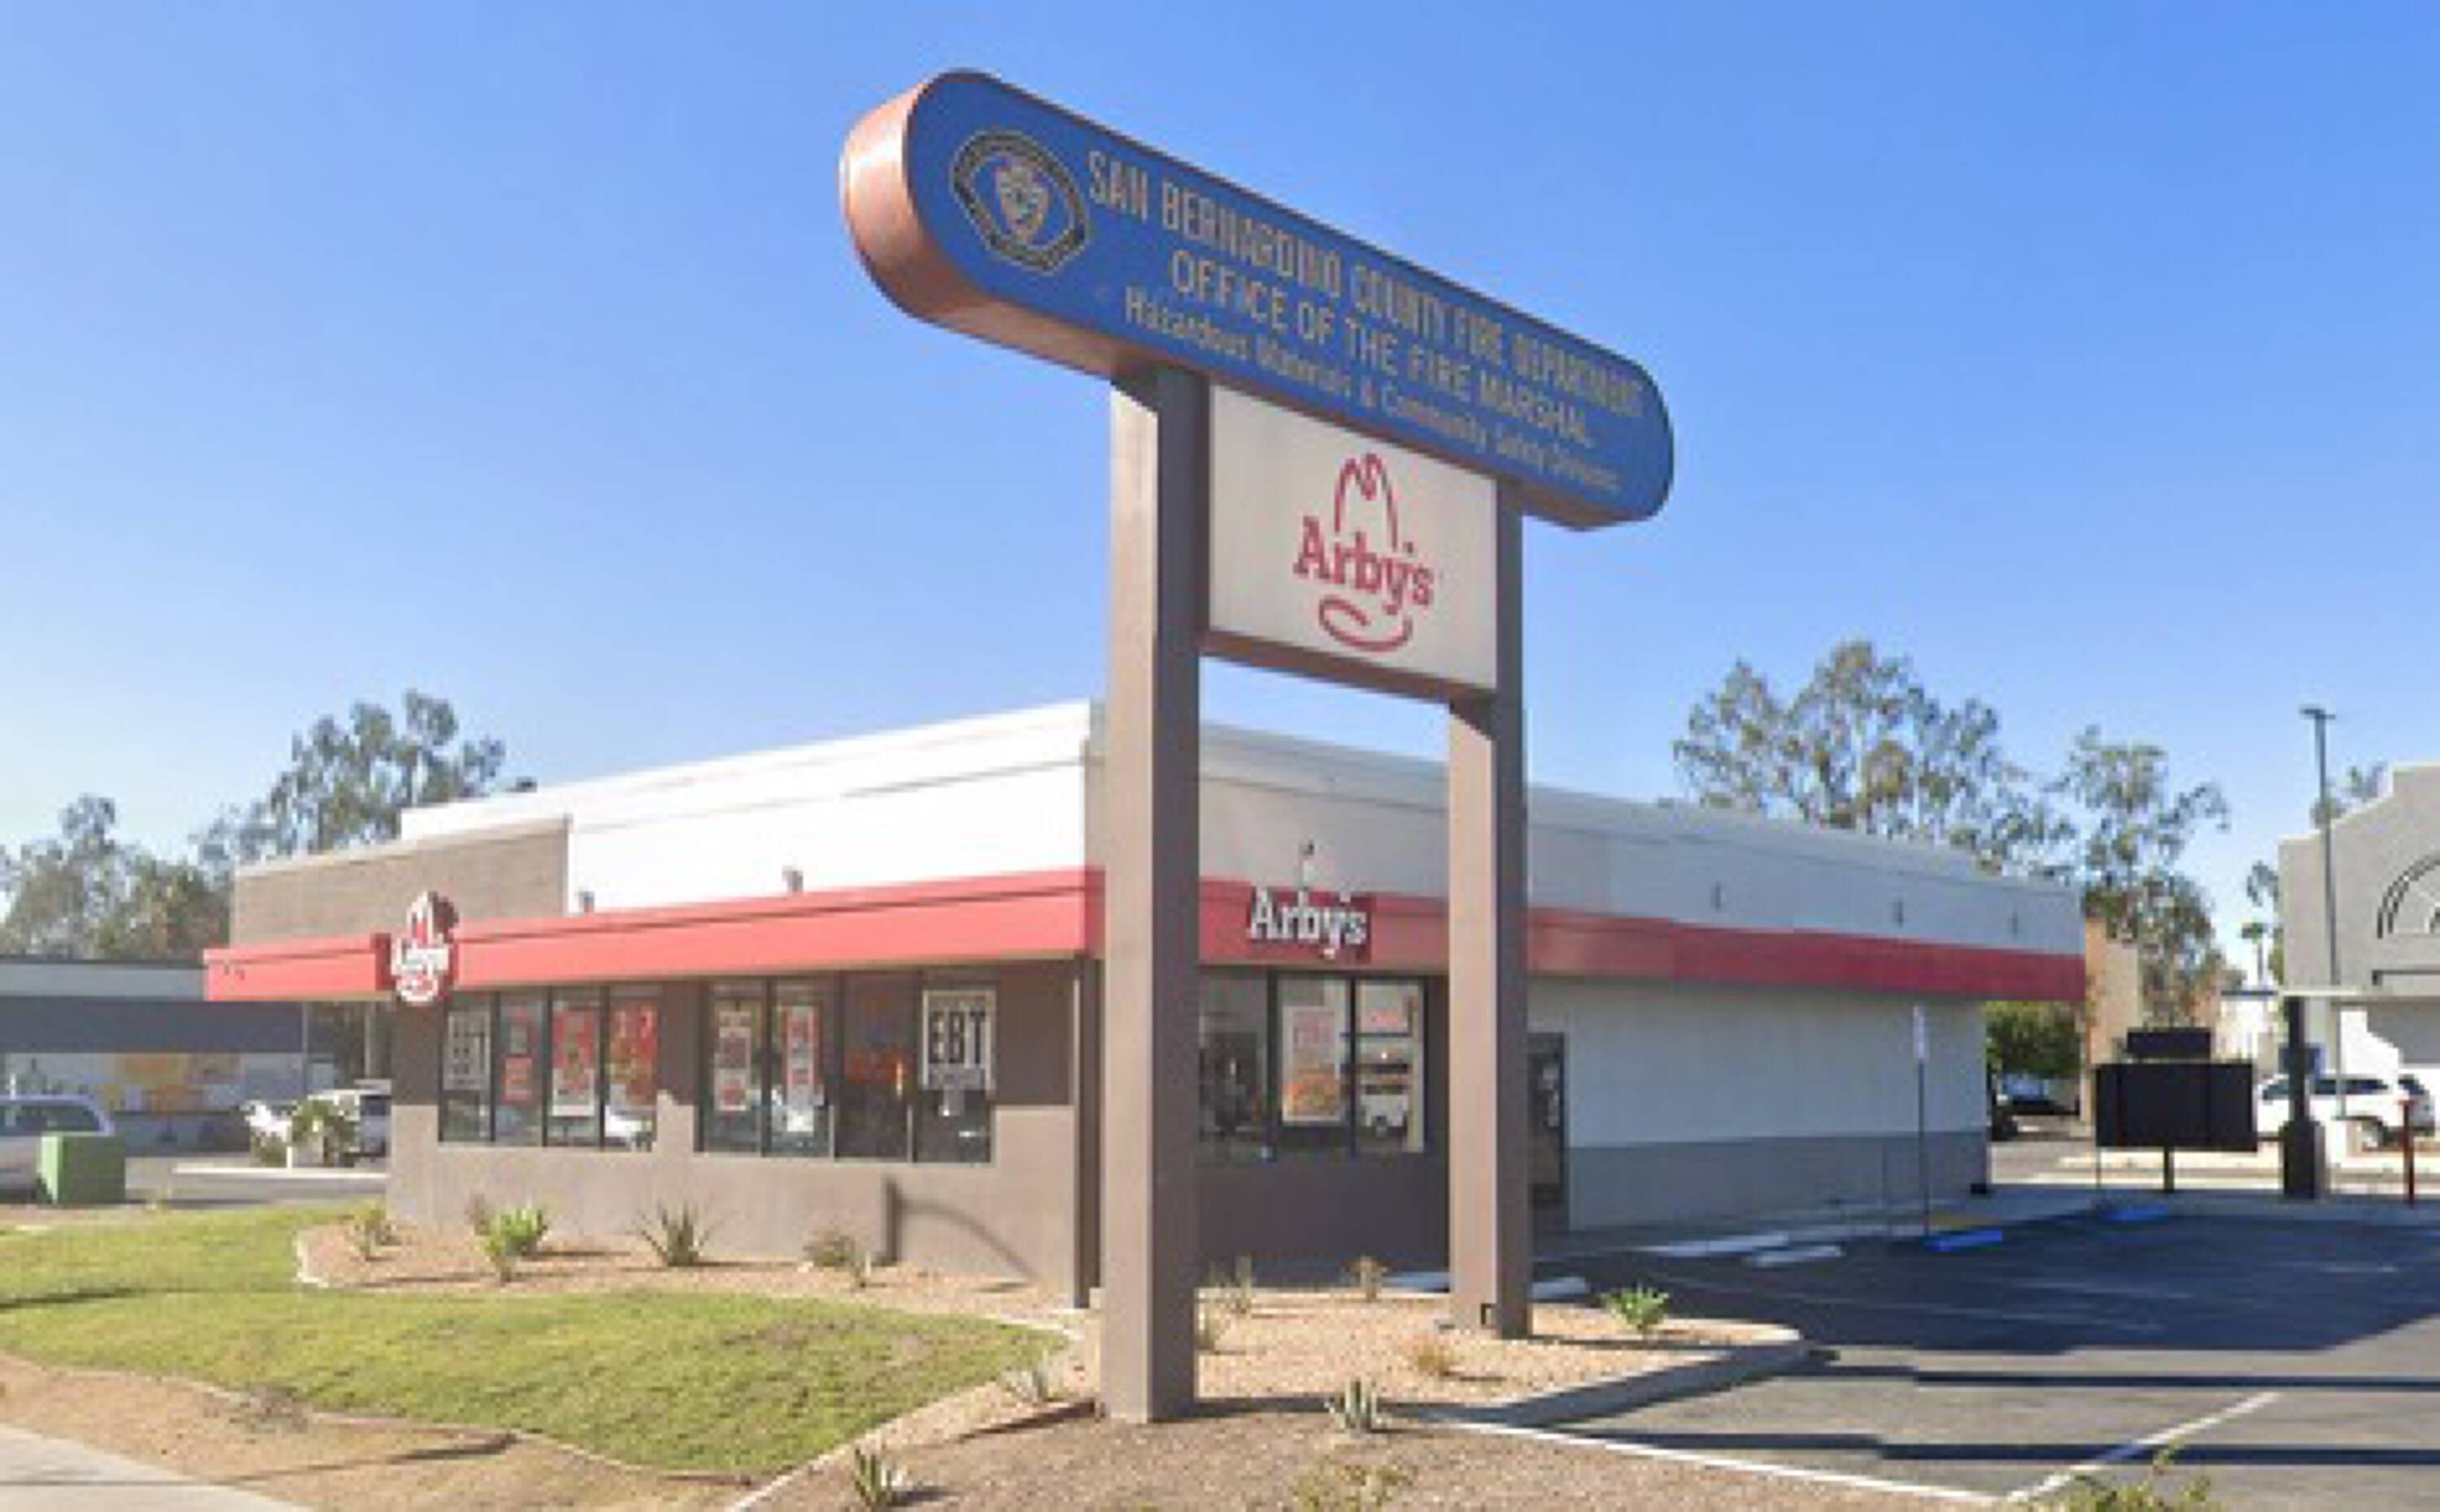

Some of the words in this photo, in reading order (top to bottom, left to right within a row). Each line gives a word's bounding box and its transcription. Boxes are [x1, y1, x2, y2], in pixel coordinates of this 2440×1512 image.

[1086, 149, 1149, 223] SAN
[1161, 181, 1341, 300] BERNARDINO
[1349, 262, 1448, 346] COUNTY
[1452, 304, 1504, 366] FIRE
[1510, 331, 1644, 418] DEPARTMENT
[1170, 249, 1288, 335] OFFICE
[1296, 298, 1335, 346] OF
[1344, 316, 1399, 378] THE
[1409, 342, 1471, 403] FIRE
[1477, 369, 1595, 449] MARSHAL
[1125, 285, 1250, 364] Hazardous
[1257, 333, 1351, 400] Materials
[1382, 379, 1488, 454] Community
[1293, 515, 1434, 615] Arby's
[1249, 889, 1368, 959] Arby's
[928, 1009, 986, 1065] EBT
